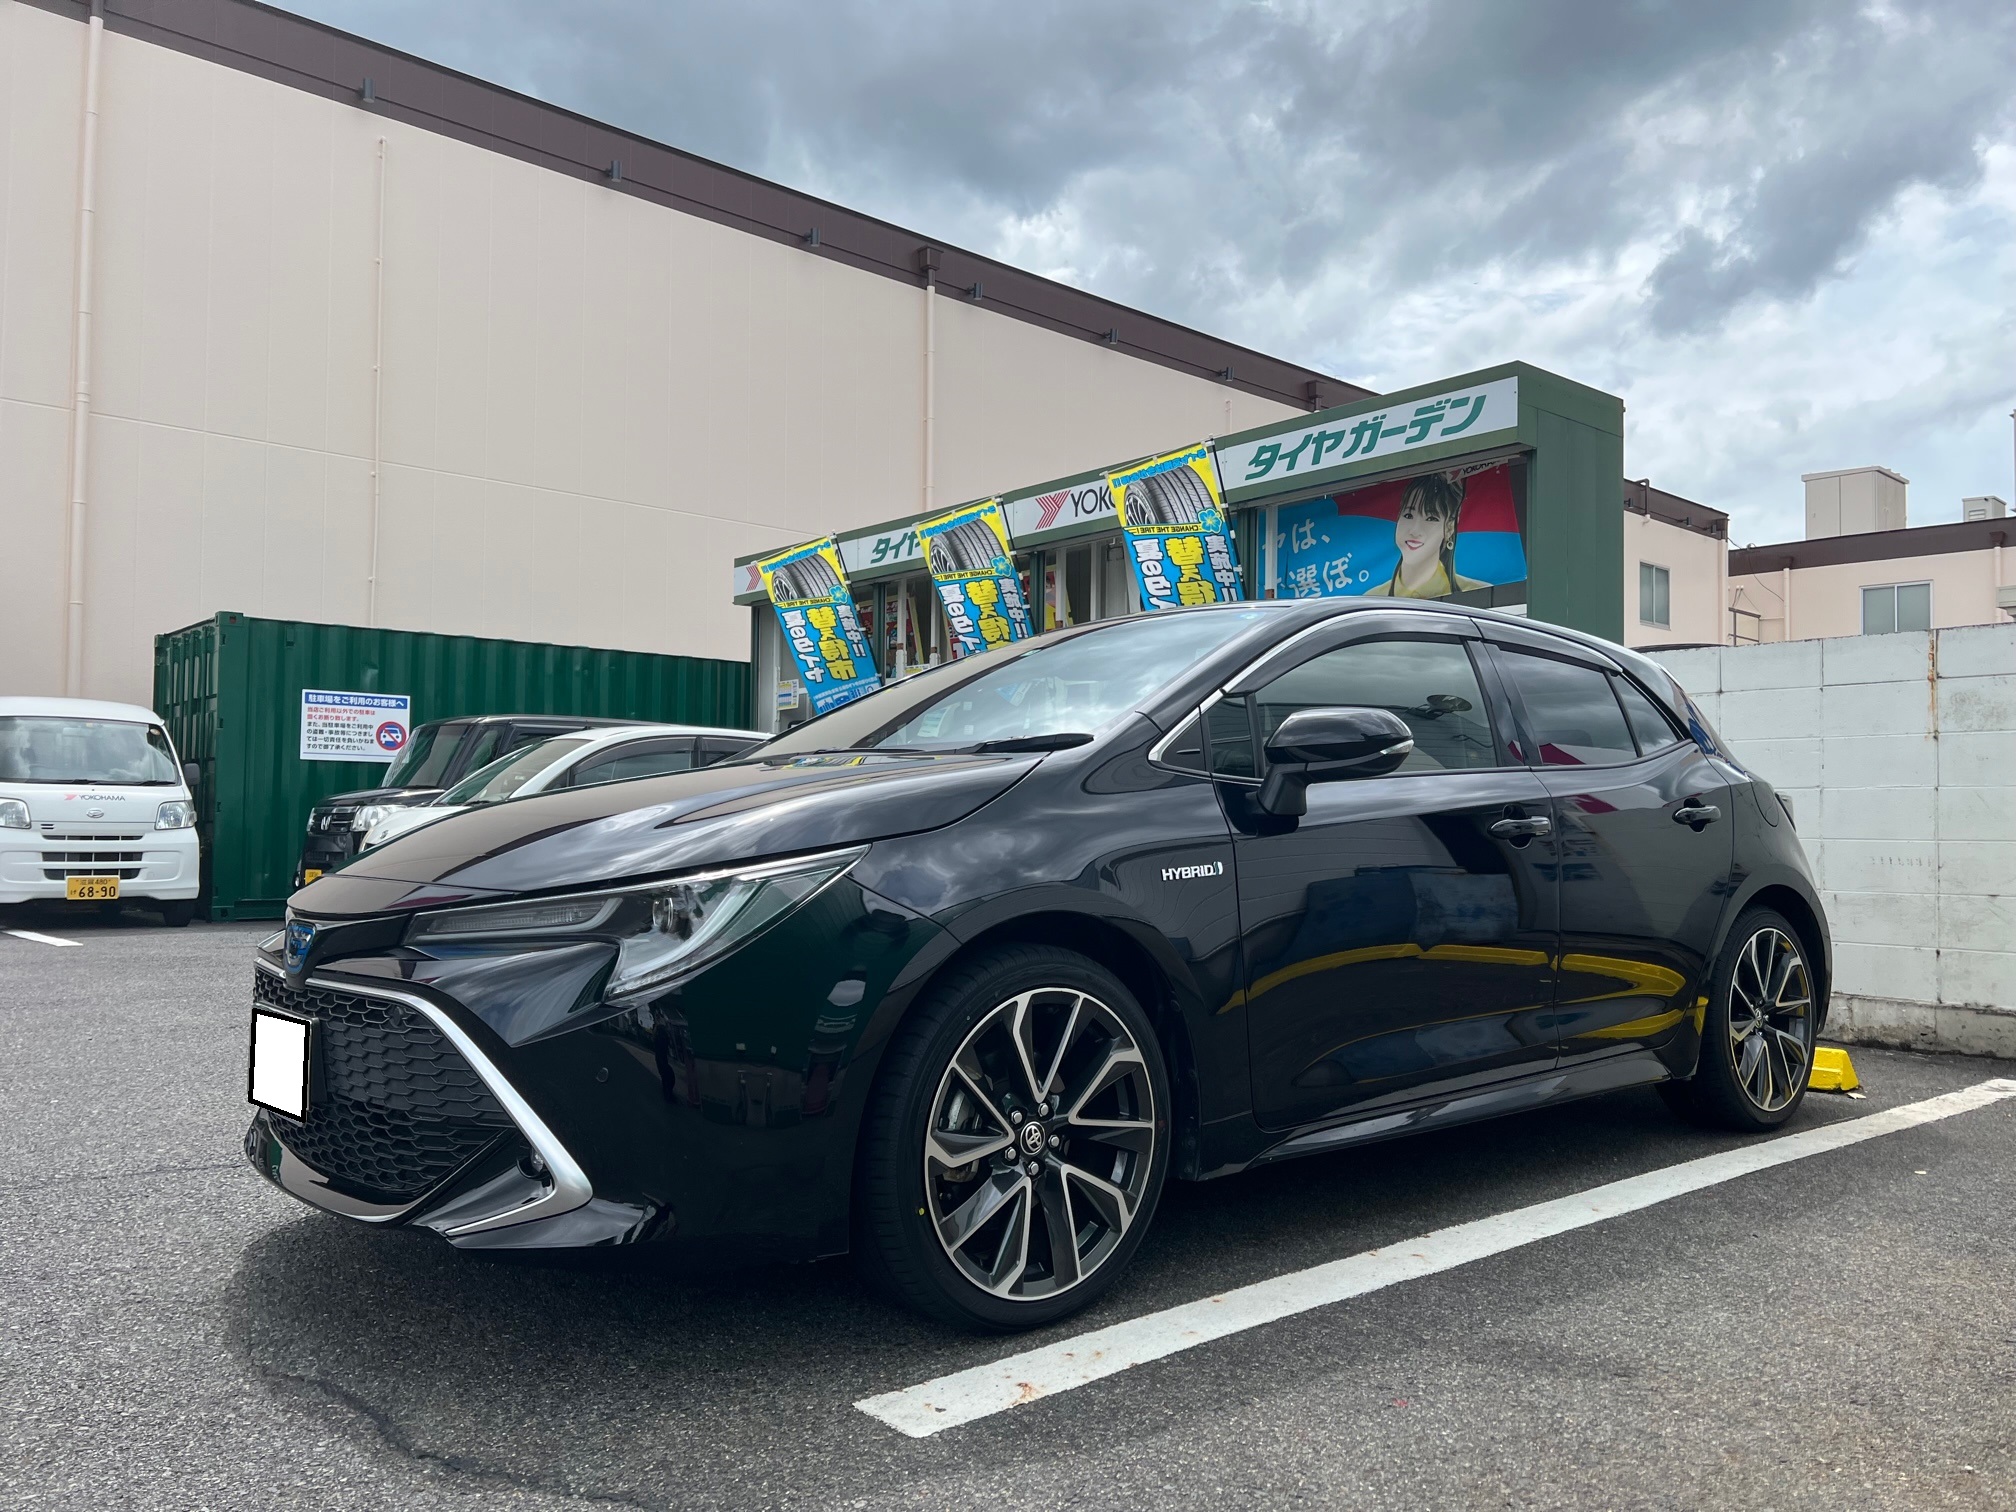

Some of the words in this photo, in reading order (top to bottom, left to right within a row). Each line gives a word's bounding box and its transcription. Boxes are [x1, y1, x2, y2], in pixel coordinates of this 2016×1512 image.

[1244, 394, 1488, 480] タイヤガーデン
[308, 694, 404, 707] 駐車場をご利用のお客様へ
[307, 706, 376, 716] 当店ご利用以外での駐車は
[306, 721, 374, 730] また、当駐車場をご利用中
[306, 736, 375, 744] ては一切責任を負いかねま
[79, 794, 126, 802] YOKOHAMA
[1161, 864, 1216, 882] HYBRID
[78, 886, 116, 898] 68-90
